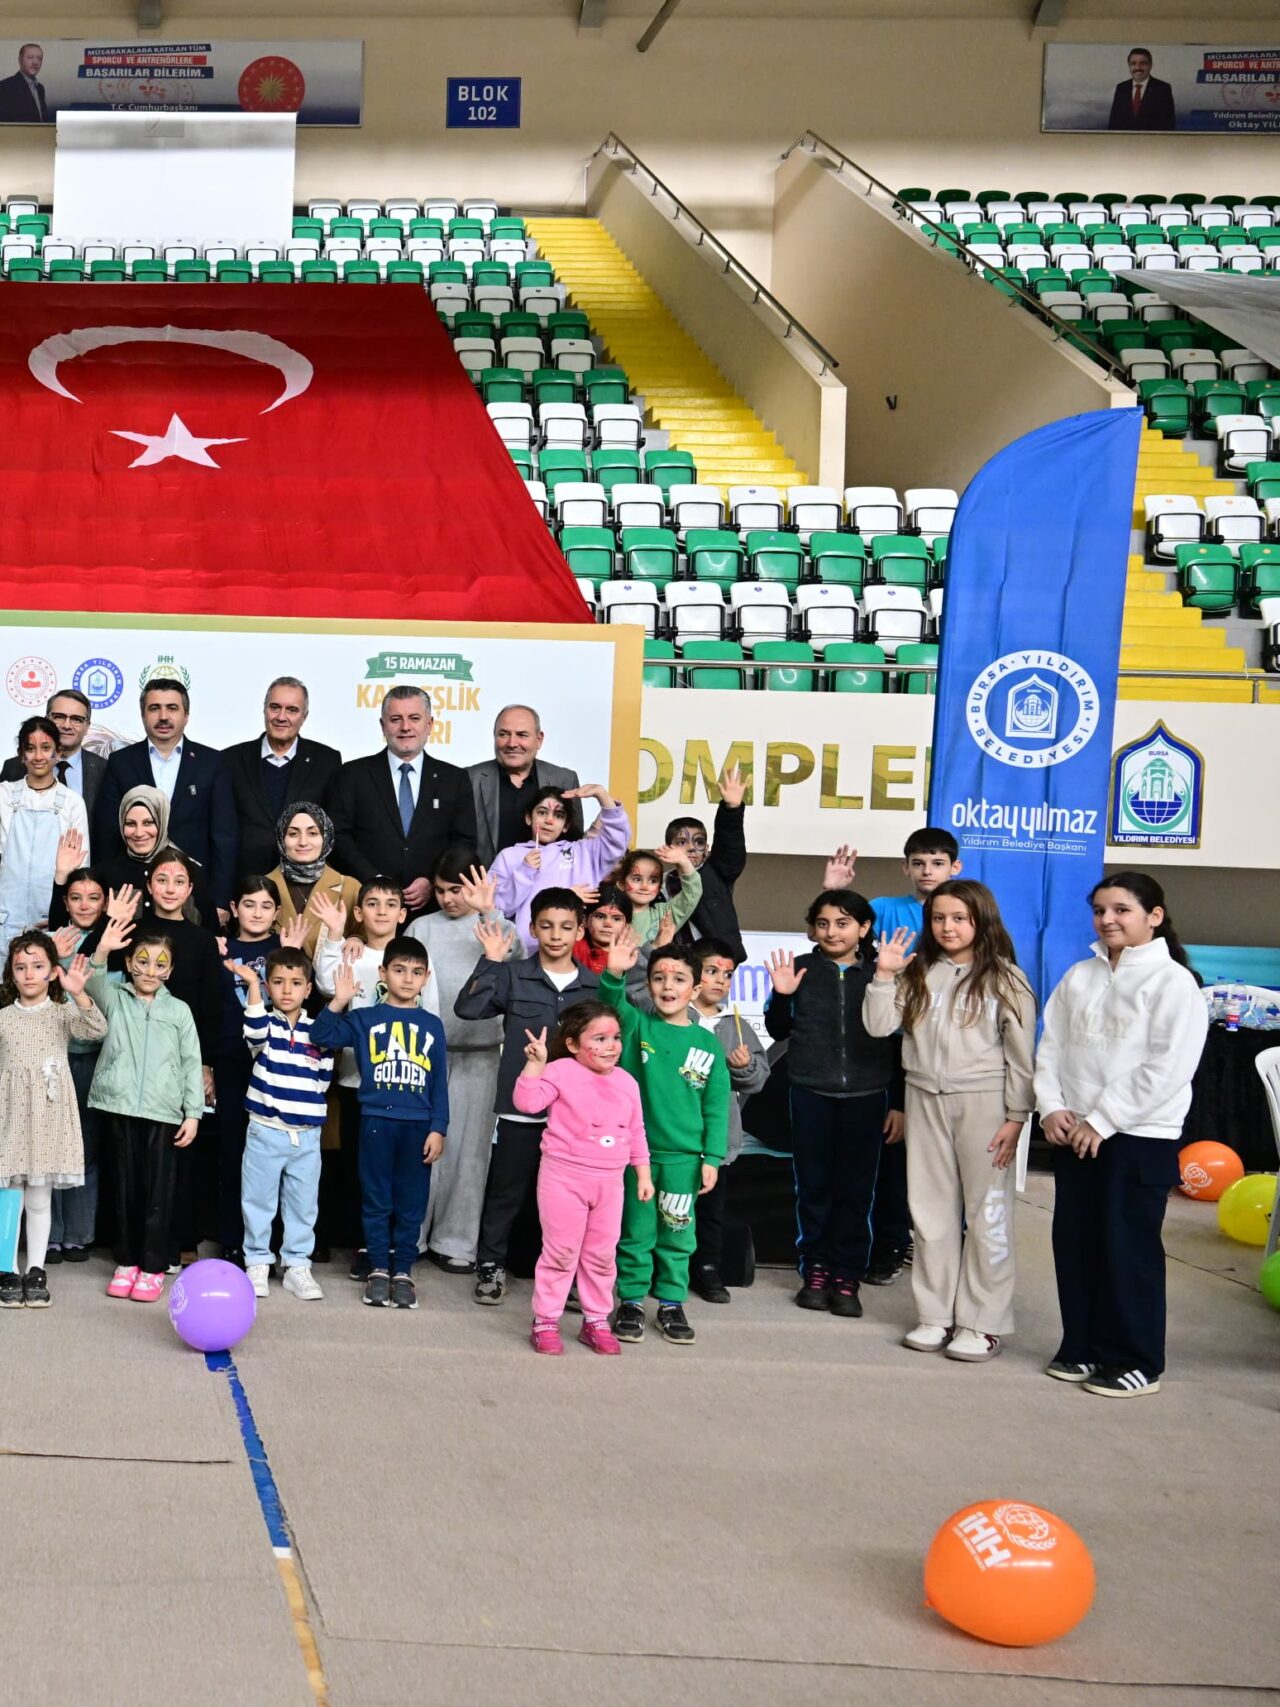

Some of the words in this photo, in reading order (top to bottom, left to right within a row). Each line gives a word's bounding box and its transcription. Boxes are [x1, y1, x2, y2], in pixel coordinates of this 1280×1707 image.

[87, 47, 152, 55] MÜSABAKALARA
[153, 45, 187, 53] KATILAN
[86, 68, 150, 78] BAŞARILAR
[153, 67, 205, 77] DİLERİM.
[1205, 73, 1275, 83] BAŞARILAR
[458, 85, 509, 101] BLOK
[128, 103, 198, 112] Cumhurbaşkanı
[468, 106, 497, 120] 102
[383, 655, 397, 669] 15
[399, 655, 456, 671] RAMAZAN
[970, 662, 1009, 714] BURSA
[1021, 654, 1095, 711] YILDIRIM
[975, 727, 1090, 764] BELEDİYESİ
[962, 836, 999, 847] Yıldırım
[1002, 837, 1045, 850] Belediye
[1047, 841, 1088, 853] Başkanı
[1113, 835, 1149, 844] YILDIRIM
[1149, 834, 1196, 845] BELEDİYESİ
[369, 1021, 435, 1072] CALI
[374, 1059, 427, 1087] GOLDEN
